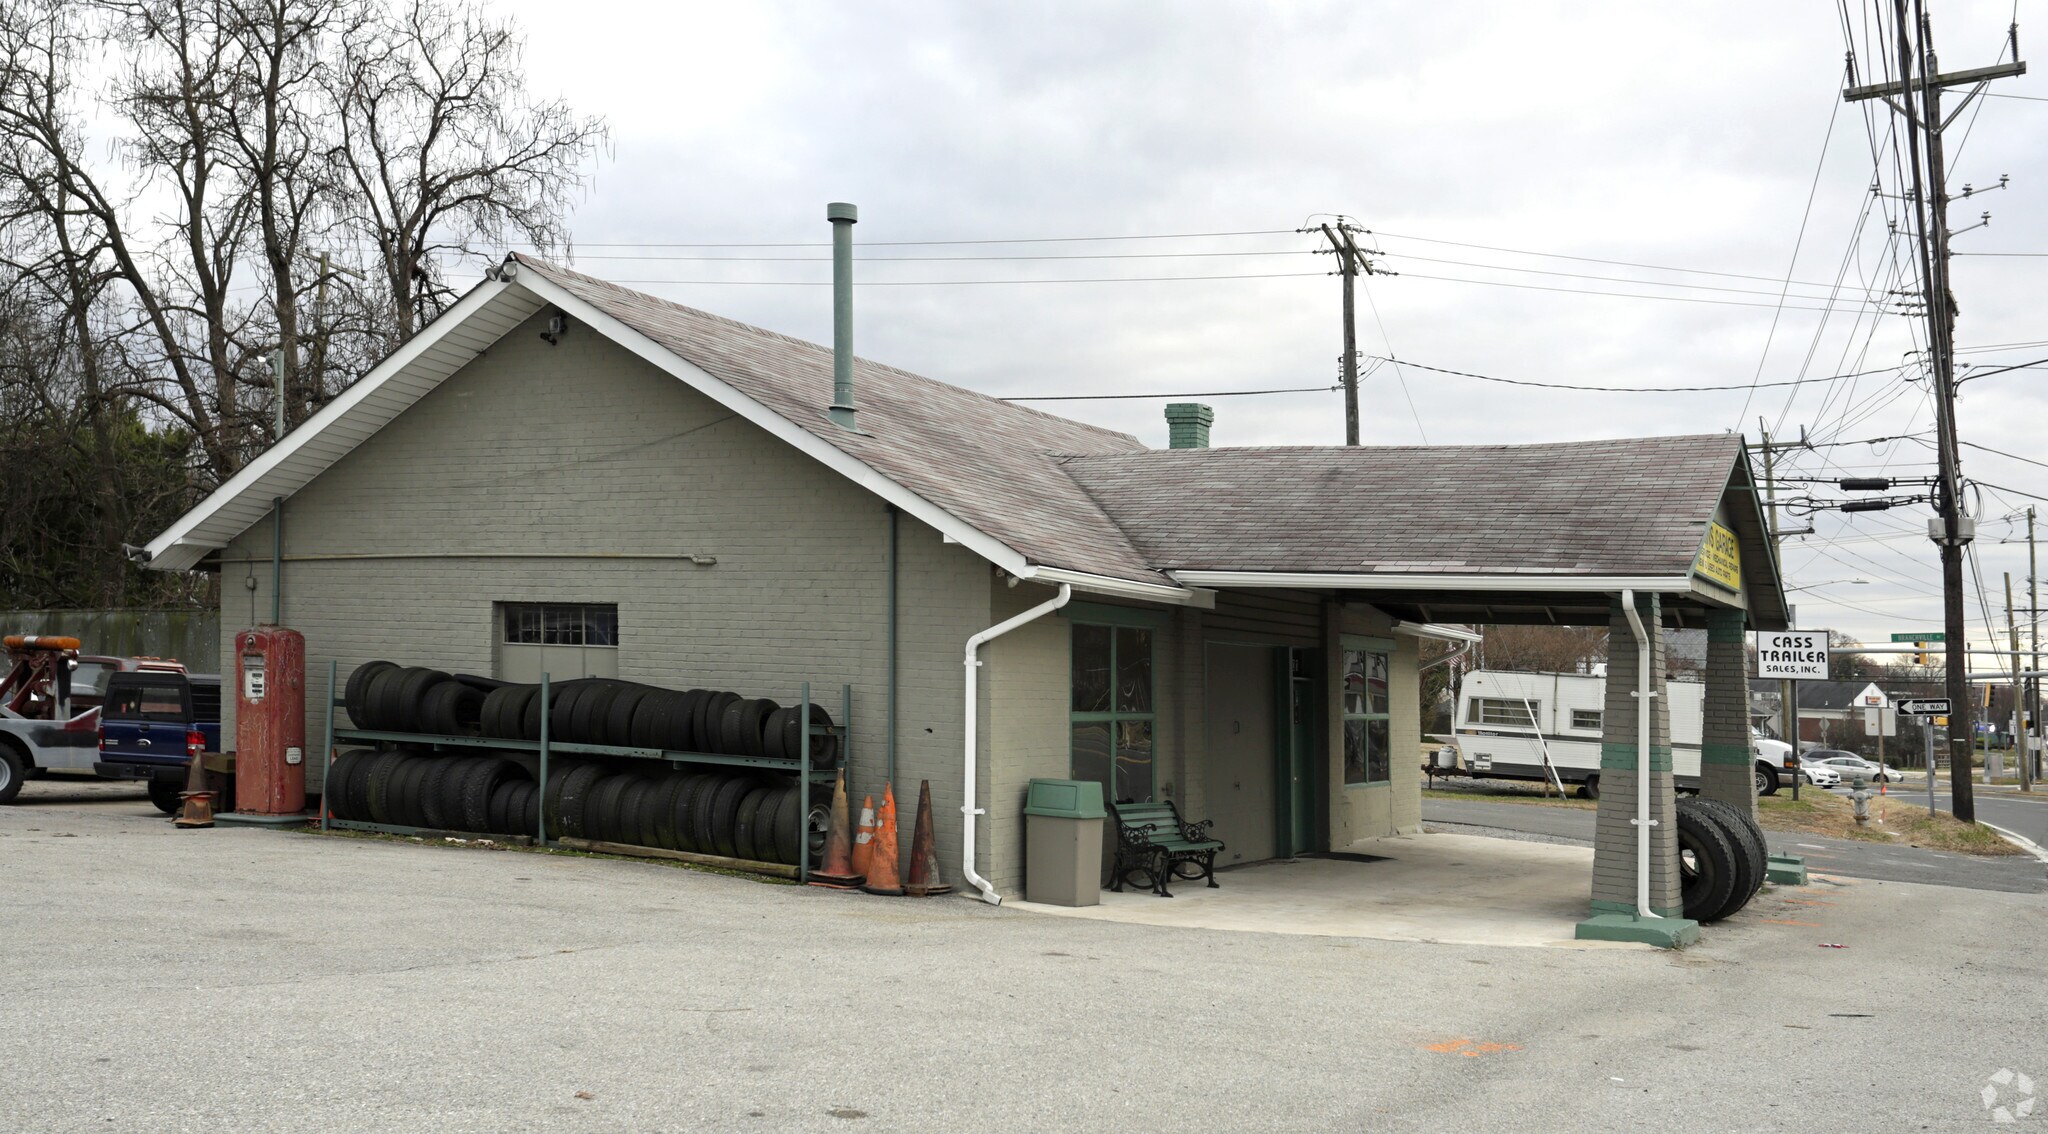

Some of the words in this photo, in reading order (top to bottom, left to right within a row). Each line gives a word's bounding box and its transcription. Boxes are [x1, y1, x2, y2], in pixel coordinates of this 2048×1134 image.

[1773, 637, 1813, 648] CASS
[1761, 650, 1825, 663] TRAILER
[1766, 665, 1799, 674] SALES,
